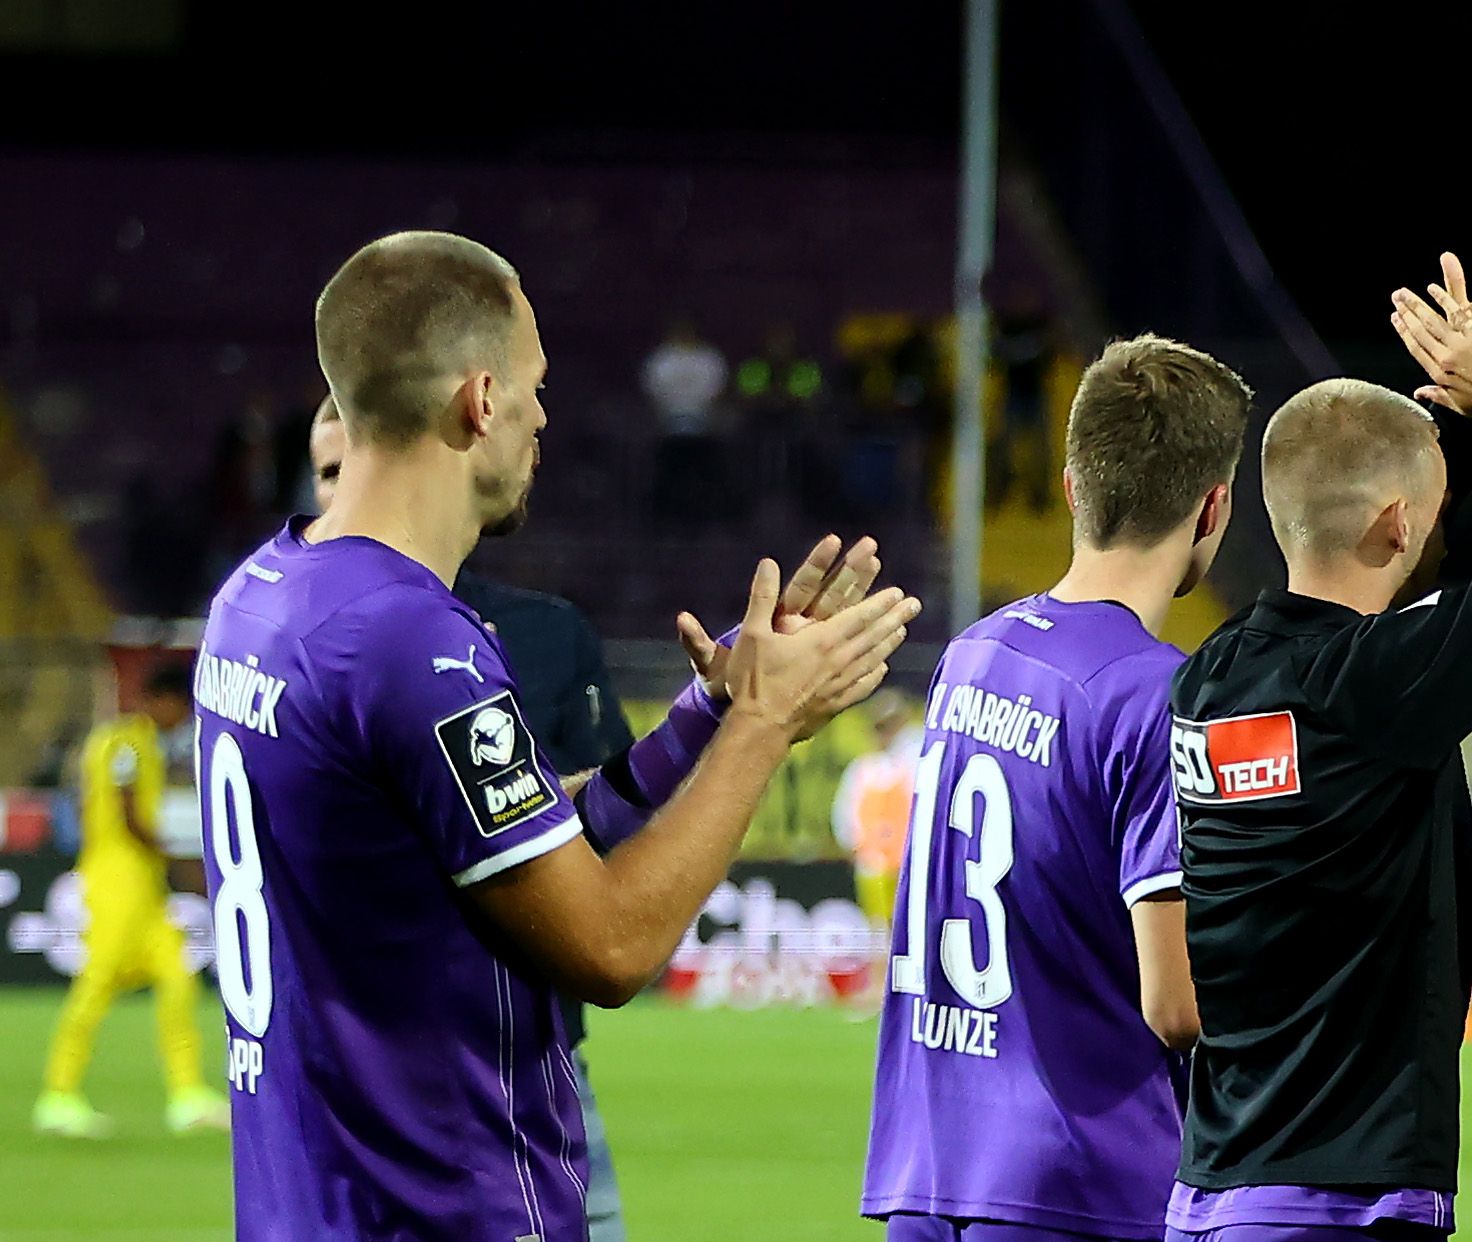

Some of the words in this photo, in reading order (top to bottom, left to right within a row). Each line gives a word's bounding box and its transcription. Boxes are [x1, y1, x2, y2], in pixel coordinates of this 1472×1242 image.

[484, 769, 541, 815] bwin
[1217, 755, 1289, 793] TECH
[891, 739, 1016, 1010] 13
